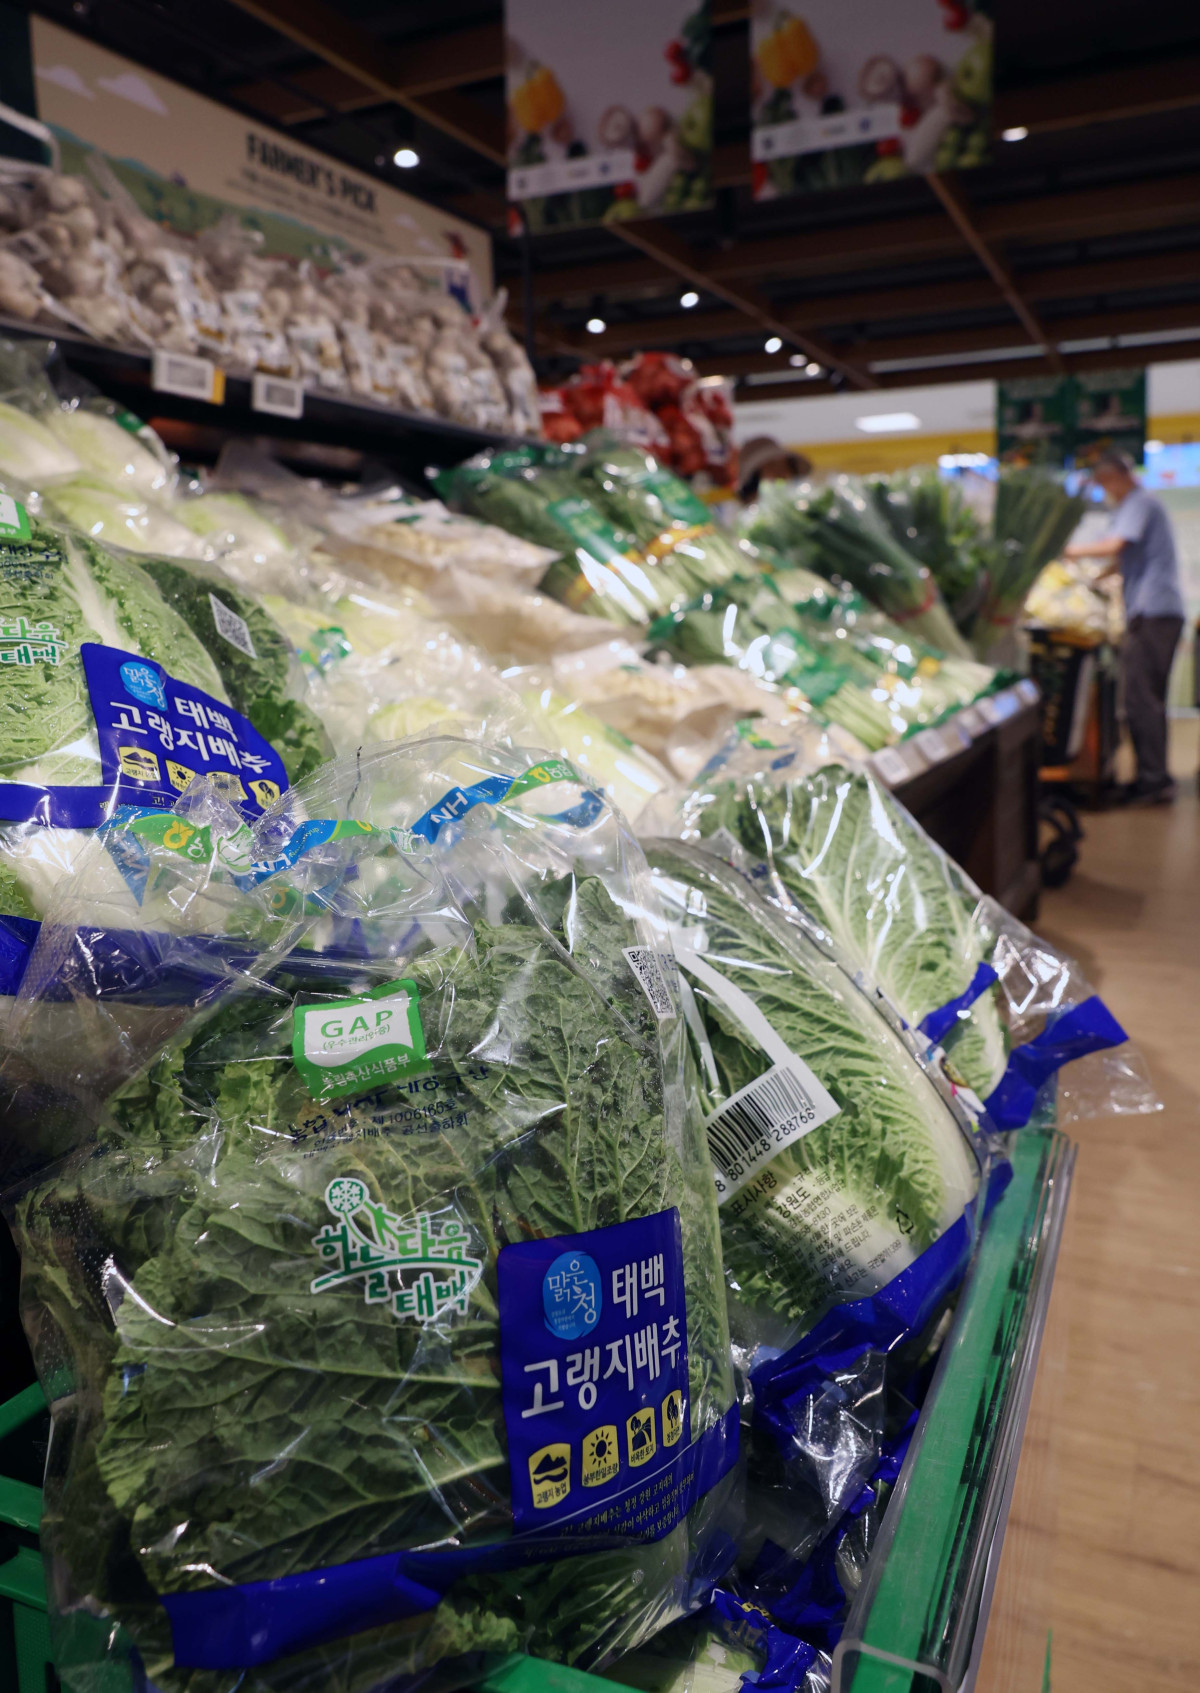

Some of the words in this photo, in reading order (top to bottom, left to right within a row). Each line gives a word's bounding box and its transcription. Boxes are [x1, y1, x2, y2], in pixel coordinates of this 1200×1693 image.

[340, 176, 376, 213] PICK
[110, 701, 272, 775] 고랭지배추
[174, 696, 239, 743] 태백
[430, 791, 469, 824] NH
[320, 1010, 394, 1039] GAP
[714, 1179, 727, 1193] 8
[727, 1138, 772, 1182] 801448
[730, 1169, 778, 1218] 표시사항
[775, 1186, 811, 1219] 강원도
[392, 1271, 469, 1321] 태백
[546, 1258, 598, 1325] 맑은청
[611, 1252, 665, 1320] 태백
[520, 1314, 683, 1419] 고랭지배추
